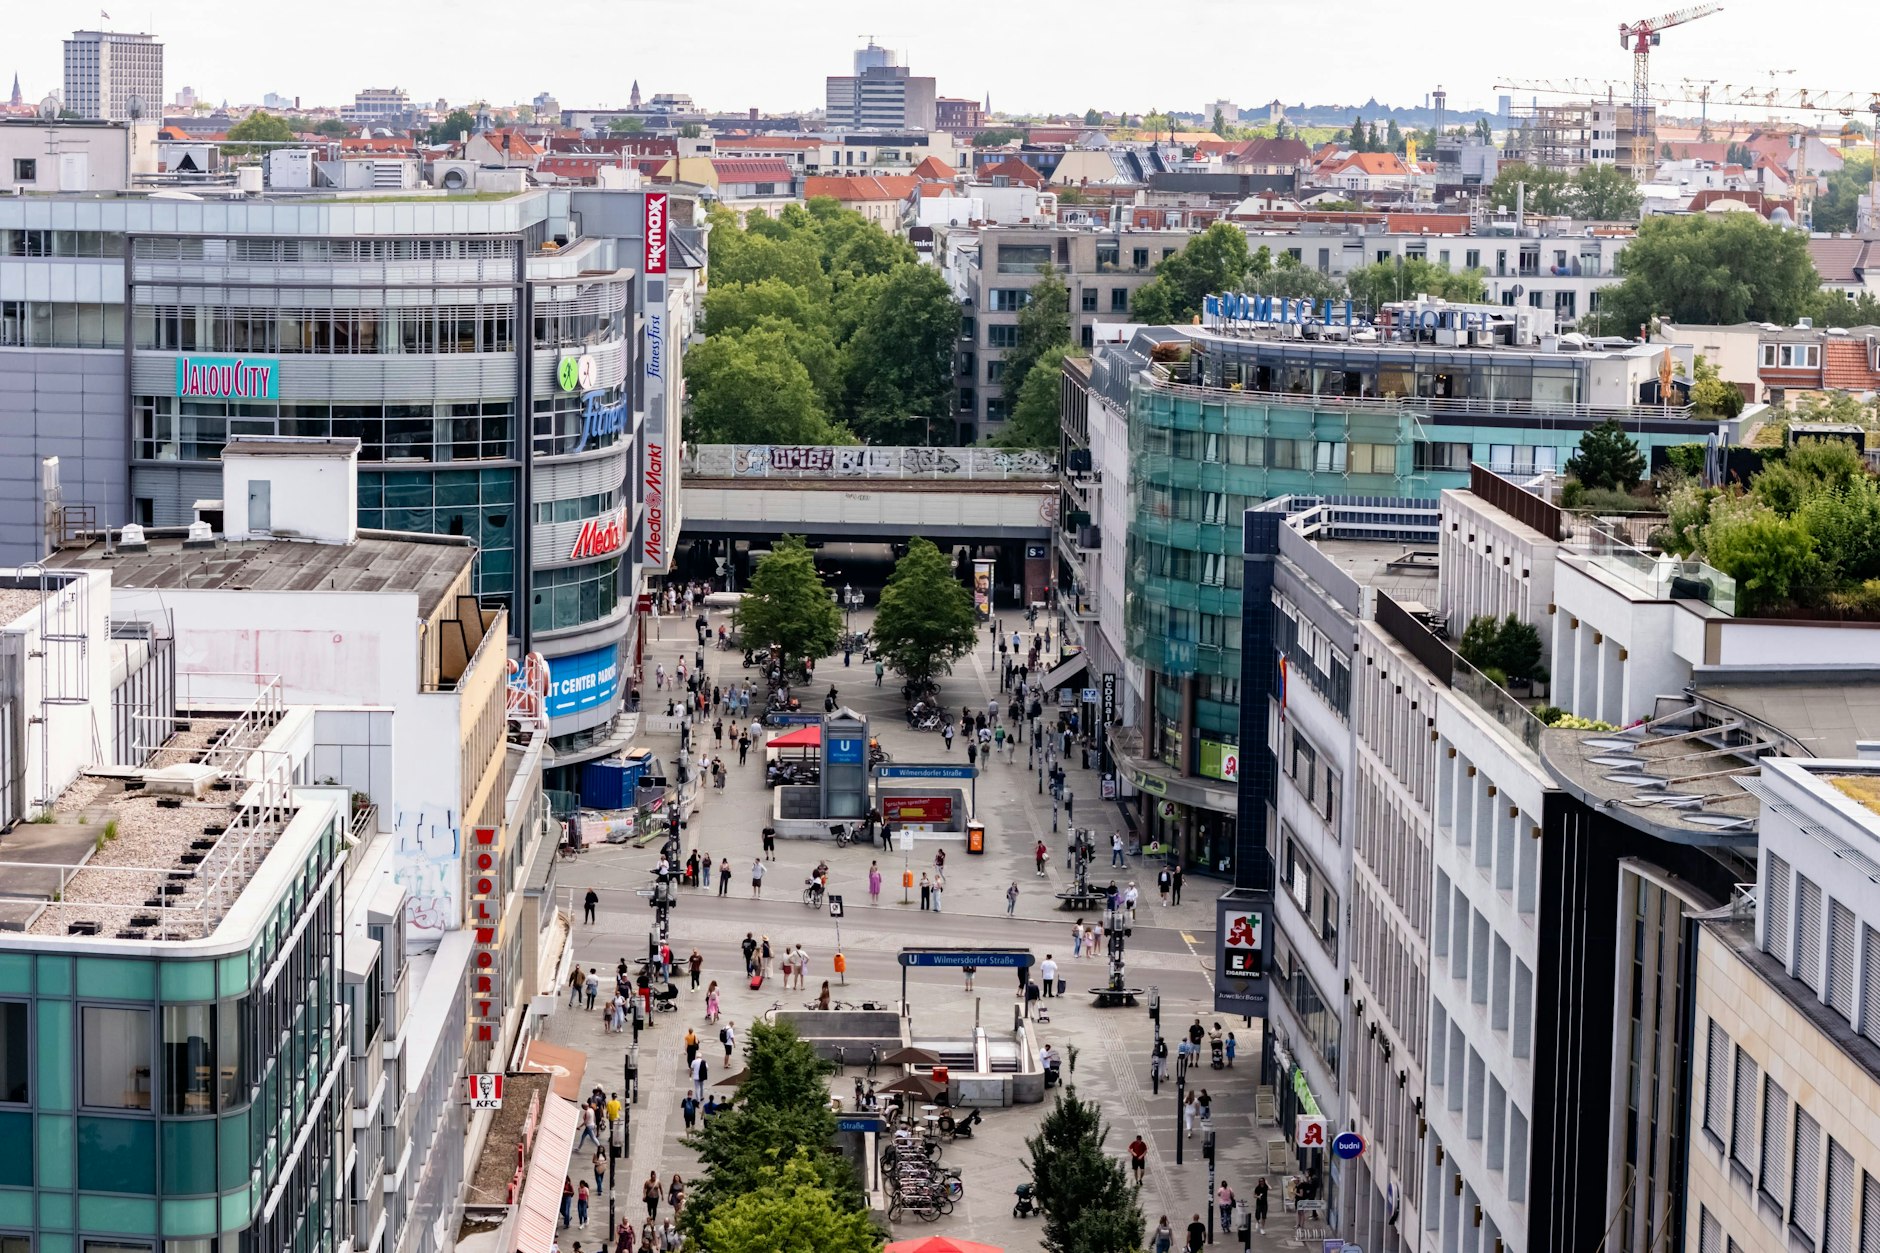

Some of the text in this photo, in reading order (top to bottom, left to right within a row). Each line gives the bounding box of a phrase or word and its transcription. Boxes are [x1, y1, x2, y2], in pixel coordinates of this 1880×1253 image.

[1029, 548, 1037, 556] S
[561, 673, 596, 695] CENTER
[1103, 674, 1113, 735] McDonald
[840, 740, 850, 751] U
[881, 768, 889, 776] U
[475, 829, 495, 1041] WOOLWORTH
[908, 954, 1015, 965] U Wilmersdorfer Straße
[1232, 955, 1244, 969] E
[842, 1121, 865, 1129] Straße
[1339, 1142, 1360, 1150] budni
